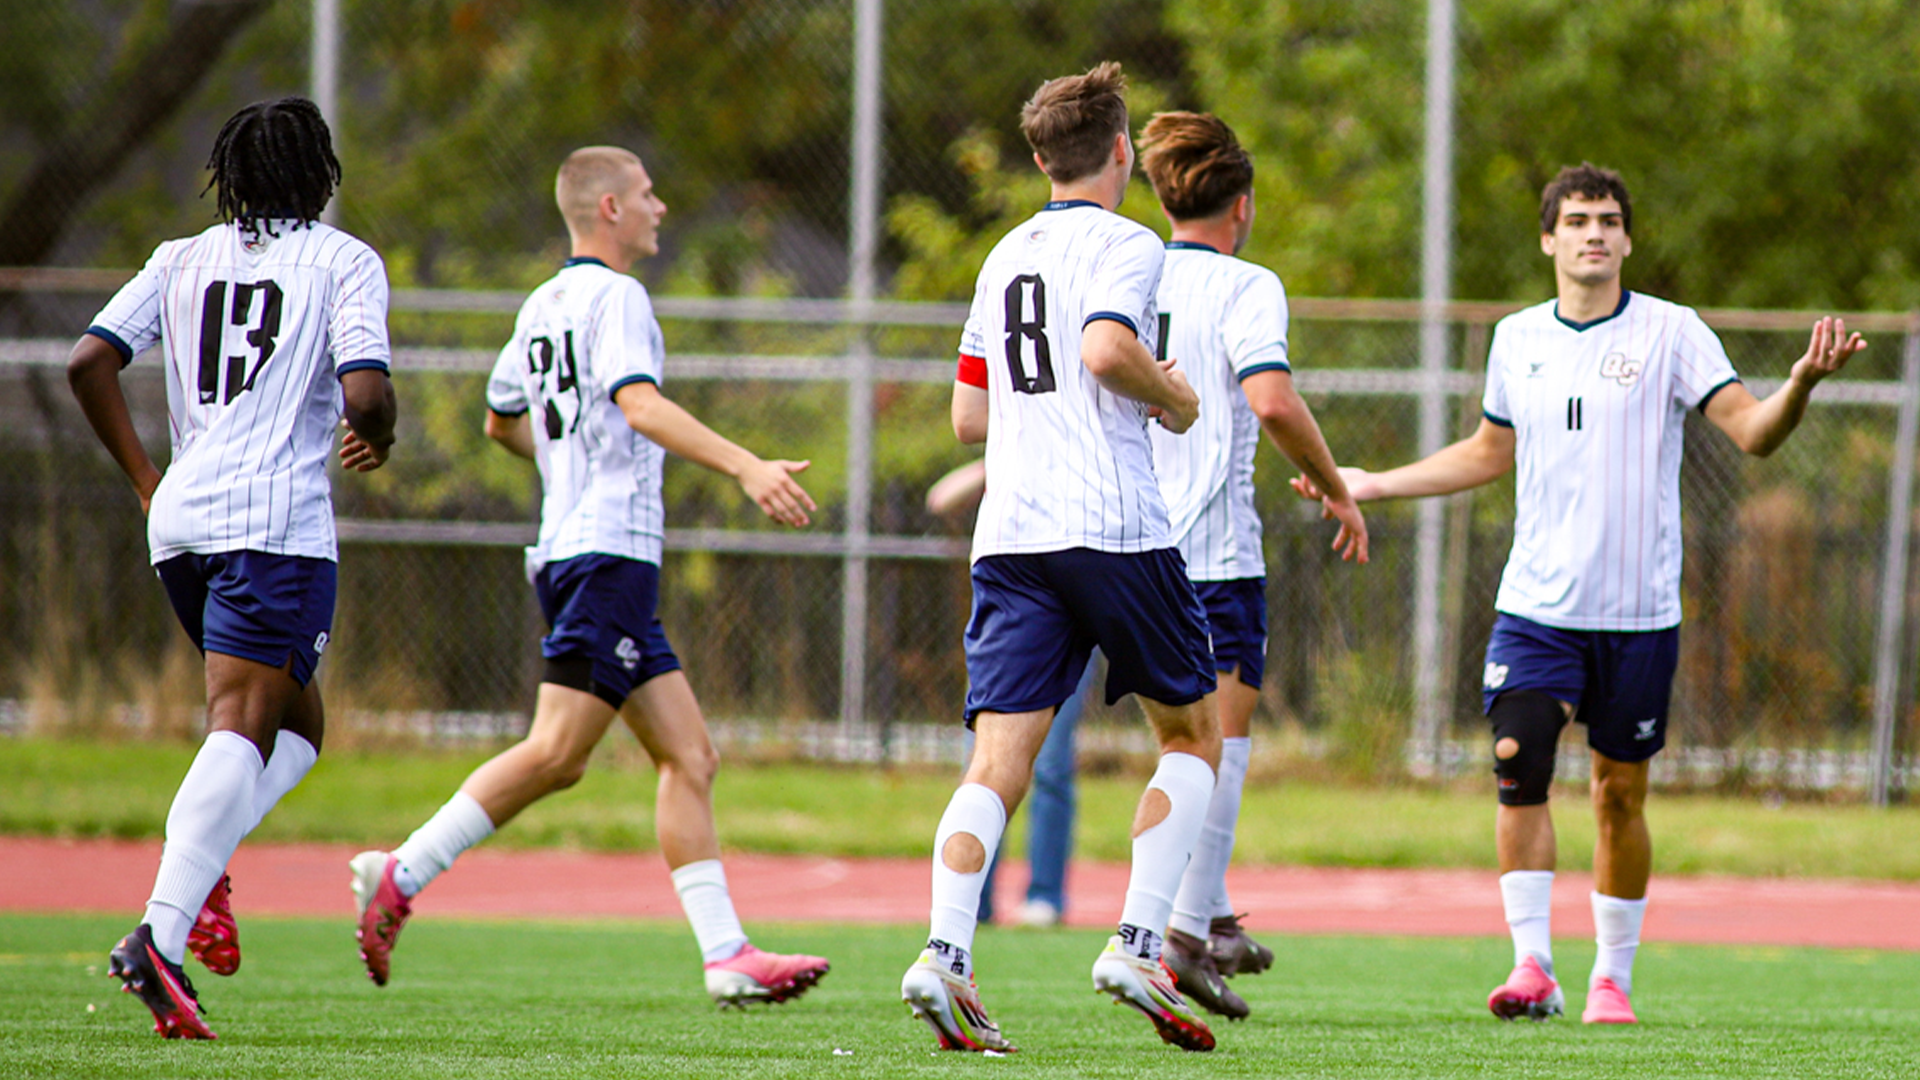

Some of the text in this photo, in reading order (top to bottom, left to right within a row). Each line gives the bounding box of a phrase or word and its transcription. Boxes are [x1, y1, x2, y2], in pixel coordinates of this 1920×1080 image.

[198, 279, 284, 406] 13
[1005, 272, 1056, 394] 8
[1567, 396, 1582, 431] 11
